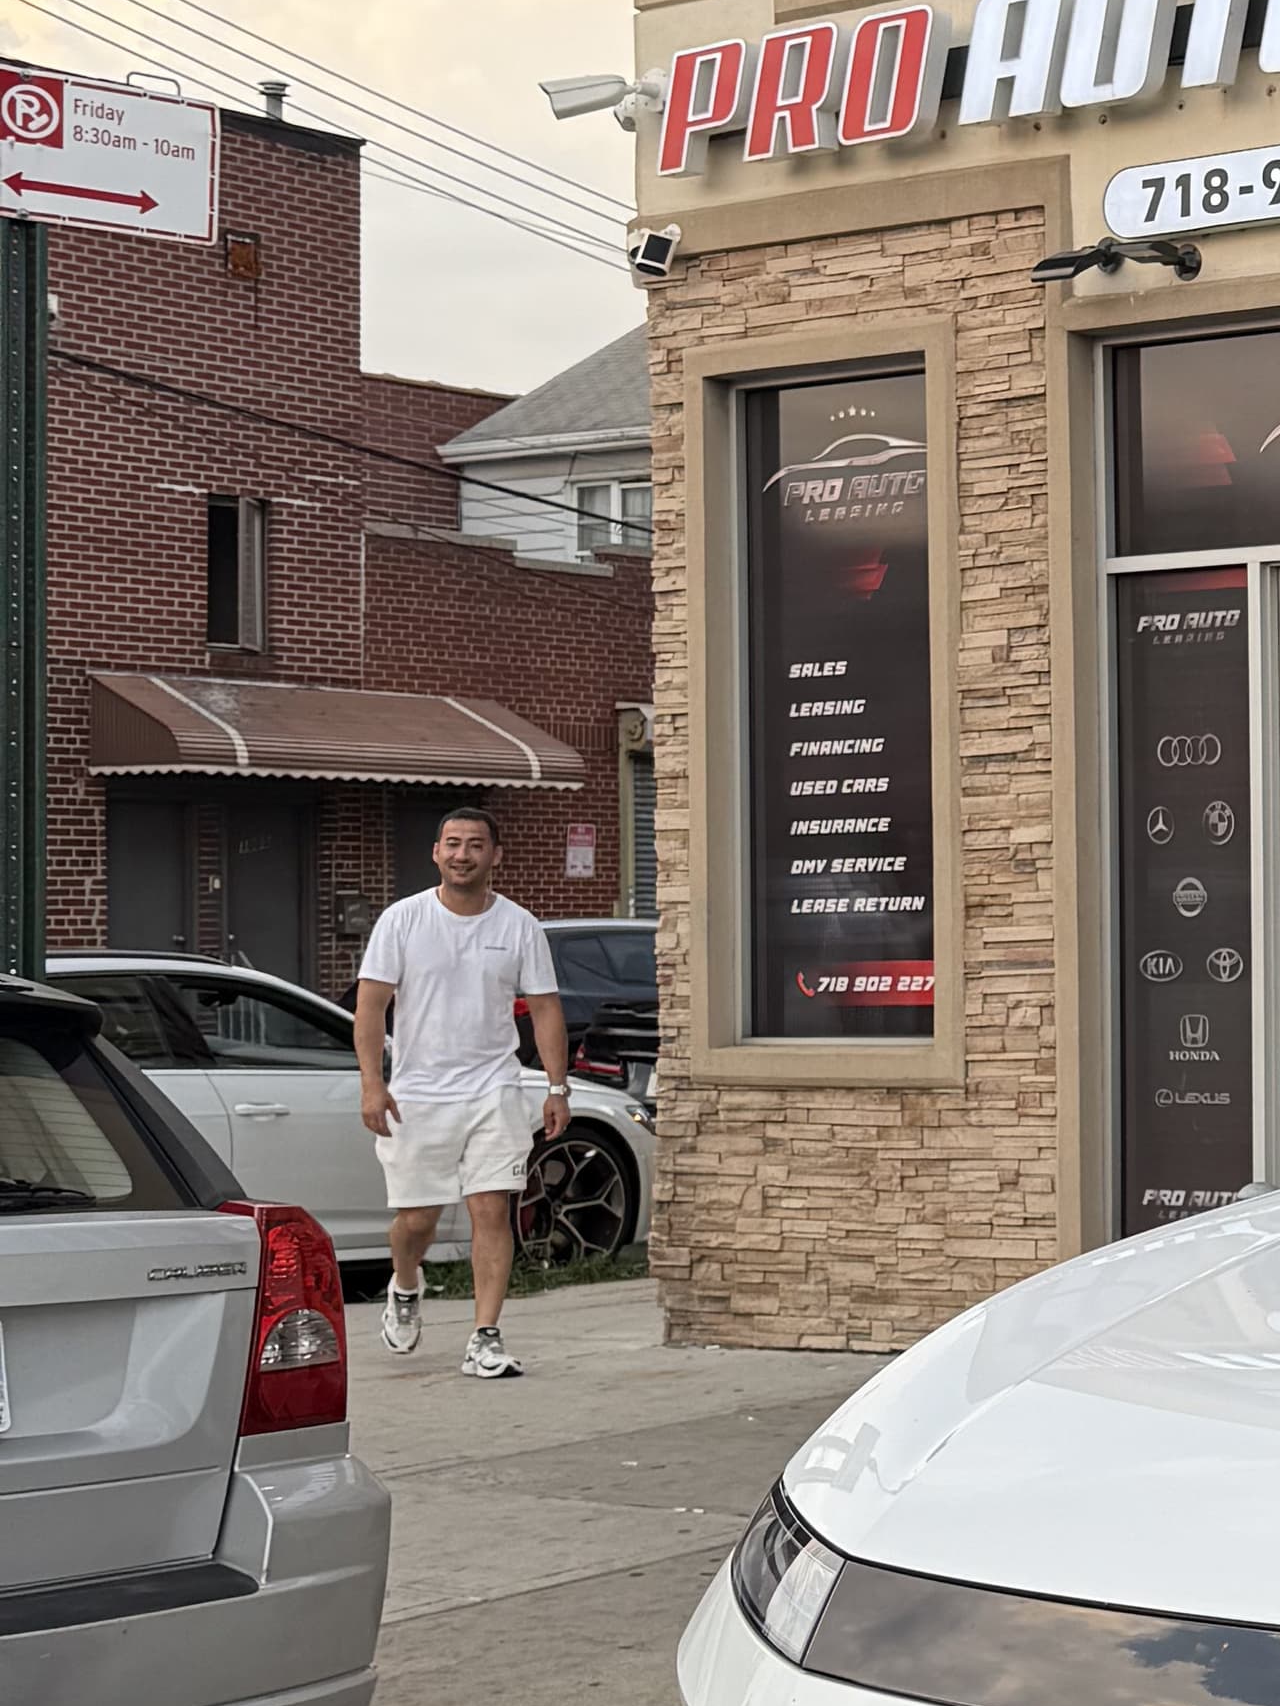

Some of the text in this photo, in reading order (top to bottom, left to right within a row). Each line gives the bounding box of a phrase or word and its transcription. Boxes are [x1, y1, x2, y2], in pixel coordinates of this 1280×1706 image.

[657, 4, 942, 177] PRO
[74, 98, 125, 125] Friday
[73, 125, 136, 151] 8:30am
[155, 138, 195, 161] 10am
[784, 470, 927, 506] PRO AUTO
[805, 501, 904, 523] LEASING
[1136, 609, 1241, 633] PRO AUTO
[789, 661, 848, 678] SALES
[789, 699, 866, 717] LEASING
[790, 738, 884, 757] FINANCING
[790, 777, 889, 796] USED CARS
[790, 818, 891, 835] INSURANCE
[791, 857, 907, 874] DMV SERVICE
[791, 896, 925, 913] LEASE RETURN
[1146, 956, 1176, 974] KIA
[817, 977, 849, 992] 718
[853, 976, 892, 991] 902
[1169, 1050, 1220, 1061] HONDA
[1175, 1091, 1231, 1105] LEXUS
[1142, 1189, 1238, 1207] PRO AUT
